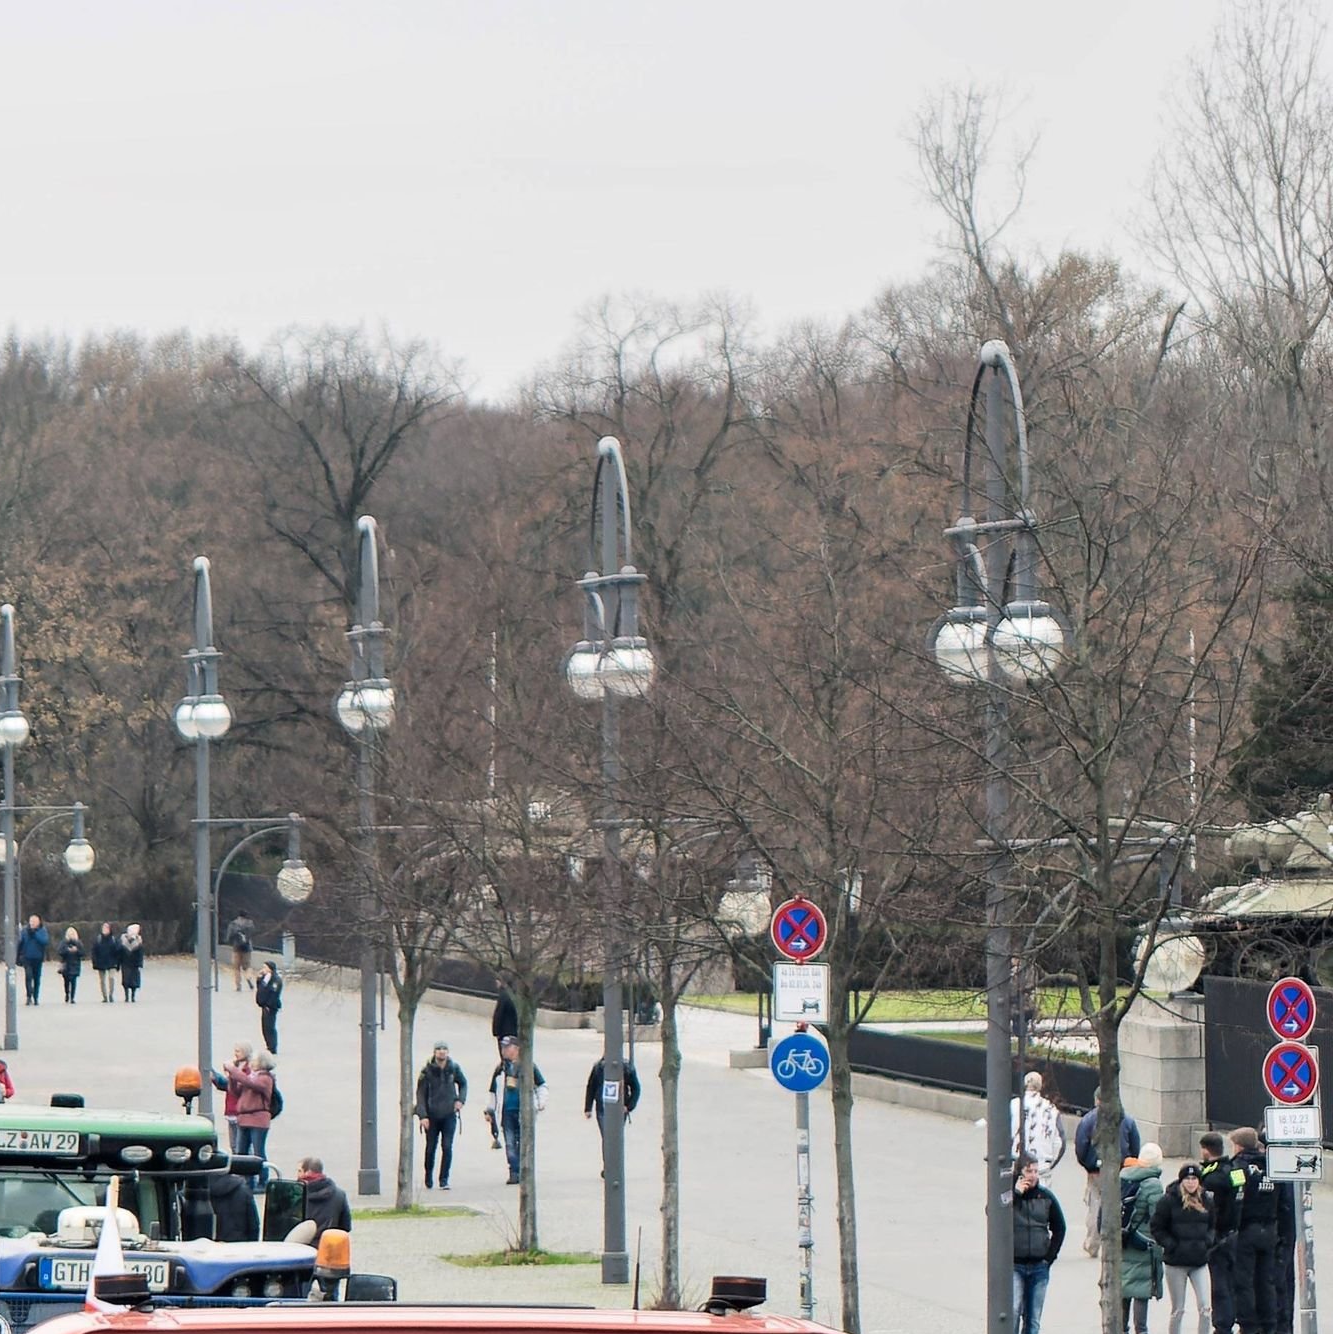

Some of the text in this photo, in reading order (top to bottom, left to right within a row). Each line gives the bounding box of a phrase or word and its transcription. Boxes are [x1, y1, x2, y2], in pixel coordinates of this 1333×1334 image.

[29, 1132, 50, 1149] AW
[55, 1133, 77, 1150] 29
[54, 1261, 90, 1283] GTH
